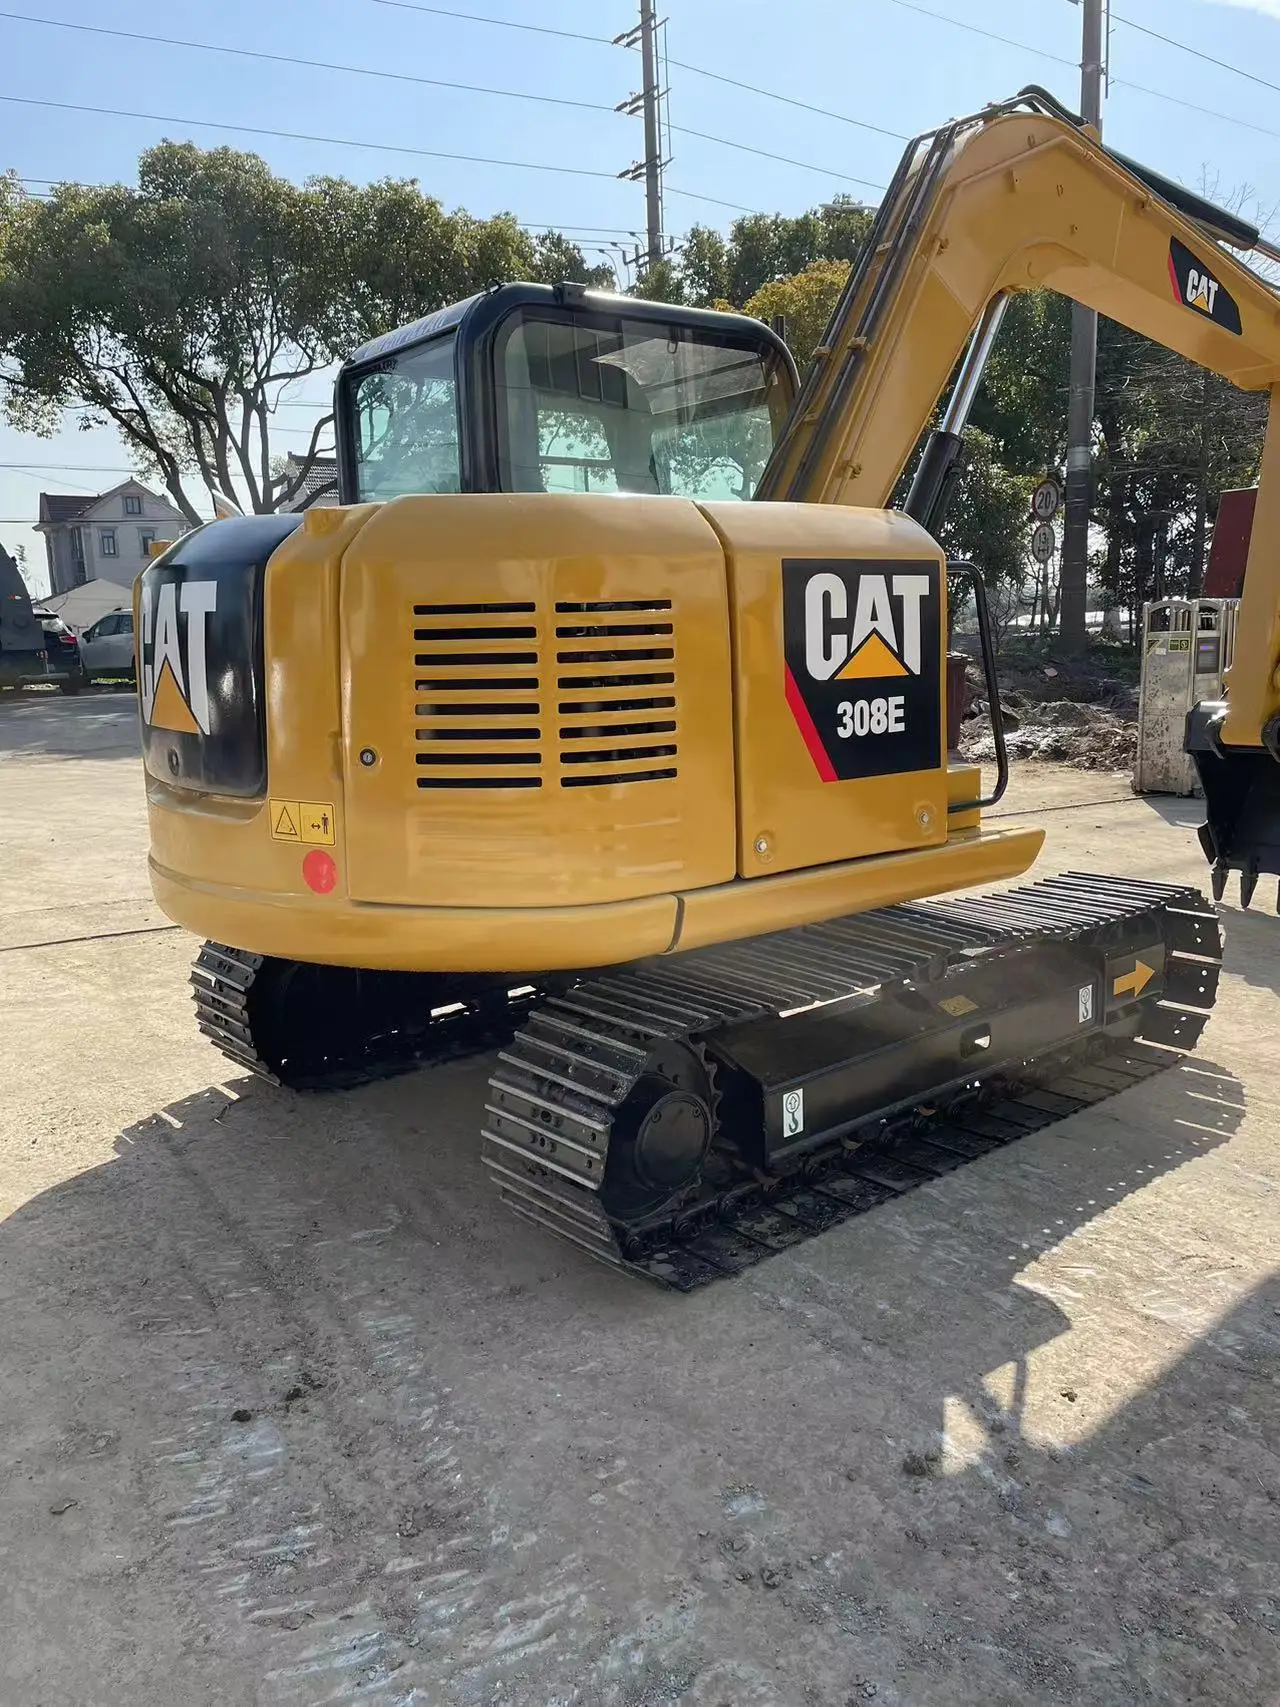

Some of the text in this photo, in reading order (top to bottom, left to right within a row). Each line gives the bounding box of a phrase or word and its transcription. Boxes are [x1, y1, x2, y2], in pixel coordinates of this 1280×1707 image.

[1186, 268, 1219, 314] CAT
[140, 580, 218, 736] CAT
[805, 572, 930, 681] CAT
[837, 695, 906, 739] 308E
